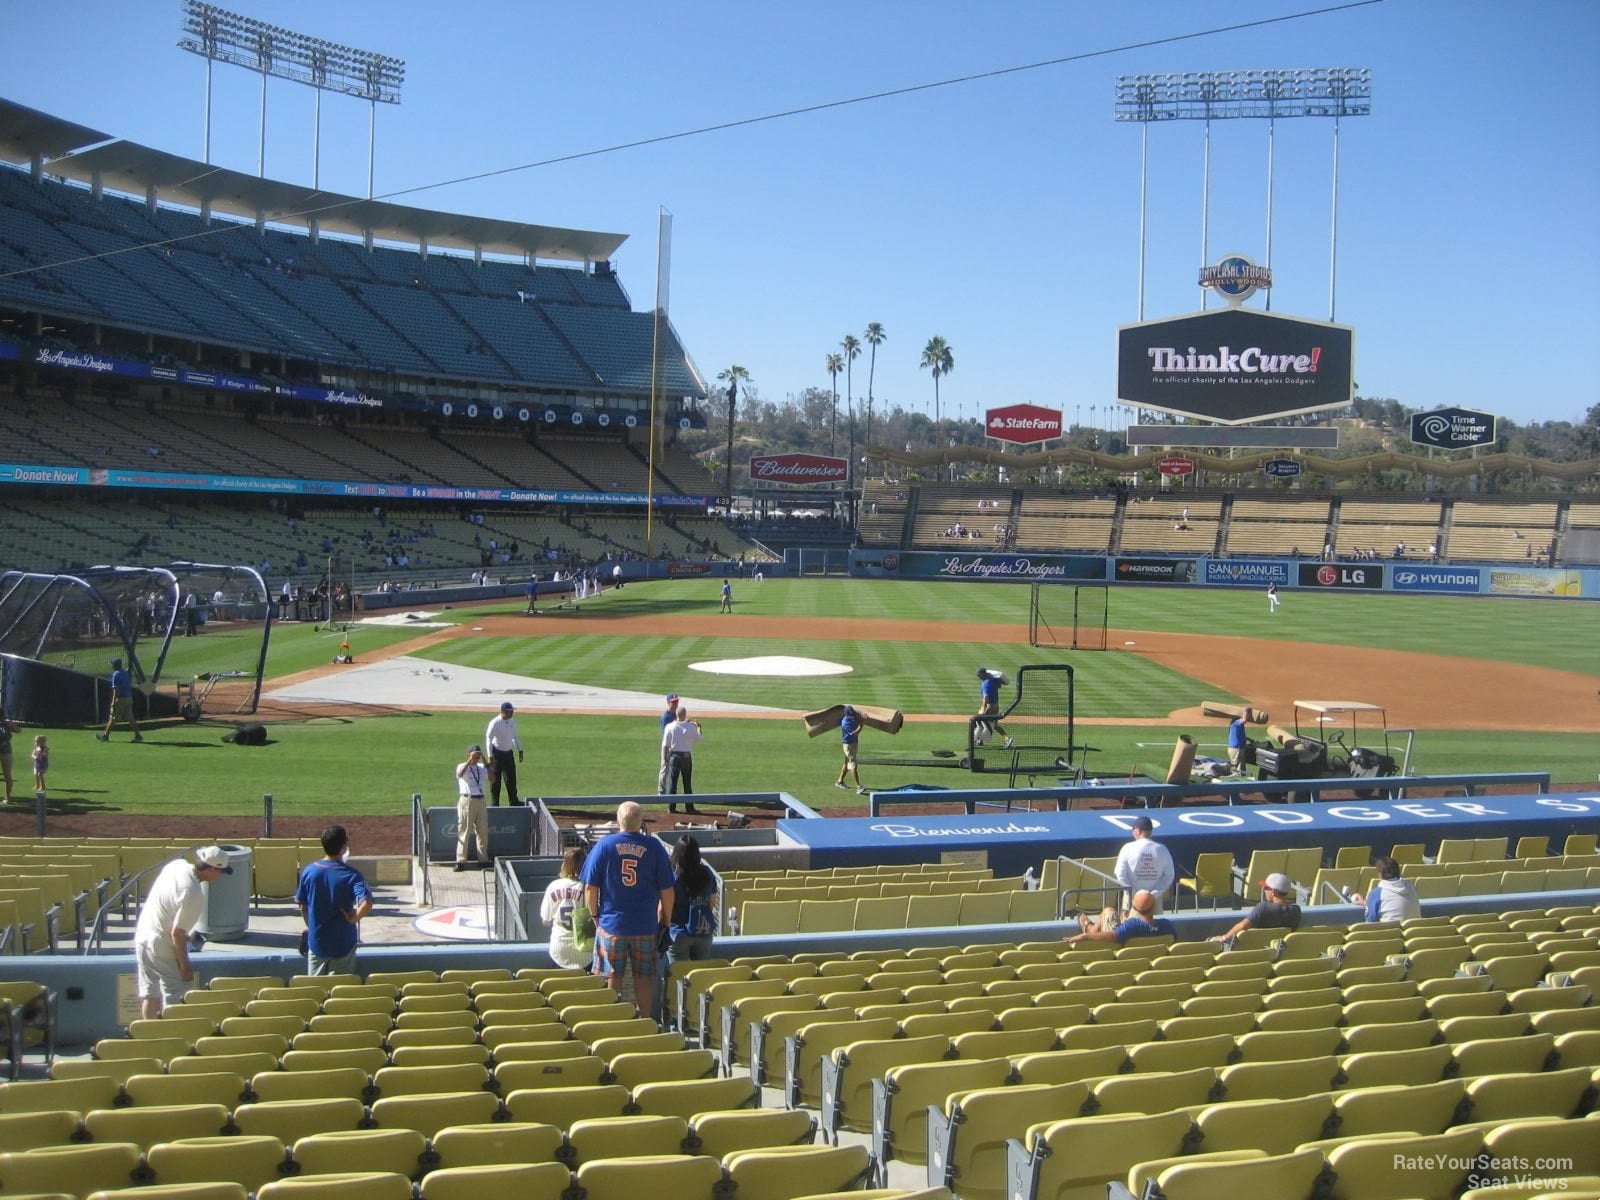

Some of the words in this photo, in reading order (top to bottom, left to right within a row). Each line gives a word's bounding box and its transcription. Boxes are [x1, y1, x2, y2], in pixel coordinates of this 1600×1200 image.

[1200, 264, 1240, 280] UNIVERSAL
[1241, 264, 1272, 281] STUDIOS
[81, 354, 114, 371] Dodgers
[1148, 346, 1321, 373] ThinkCure!
[1165, 376, 1191, 384] official
[1192, 376, 1217, 385] charity
[1285, 377, 1315, 386] Dodgers
[1451, 415, 1476, 424] Time
[1451, 424, 1487, 433] Warner
[1450, 432, 1479, 441] Cable
[15, 468, 51, 481] Donate
[53, 470, 79, 482] Now!
[754, 460, 845, 476] Budweiser
[344, 484, 358, 494] Text
[379, 487, 386, 495] to
[412, 488, 421, 497] Be
[456, 490, 464, 498] in
[464, 490, 476, 498] the
[510, 491, 537, 501] Donate
[538, 492, 558, 501] Now!
[962, 557, 1012, 577] Angeles
[1011, 558, 1065, 579] Dodgers
[1128, 565, 1174, 573] HANKOOK
[1208, 564, 1231, 574] SAN
[1240, 565, 1286, 575] MANUEL
[1341, 569, 1365, 584] LG
[1420, 575, 1479, 585] HYUNDAI
[1100, 802, 1509, 830] DODGER
[870, 822, 1050, 838] Bienvenidos
[616, 842, 648, 858] WRIGHT
[622, 859, 638, 887] 5
[550, 888, 583, 903] WRIGHT
[560, 906, 574, 931] 5
